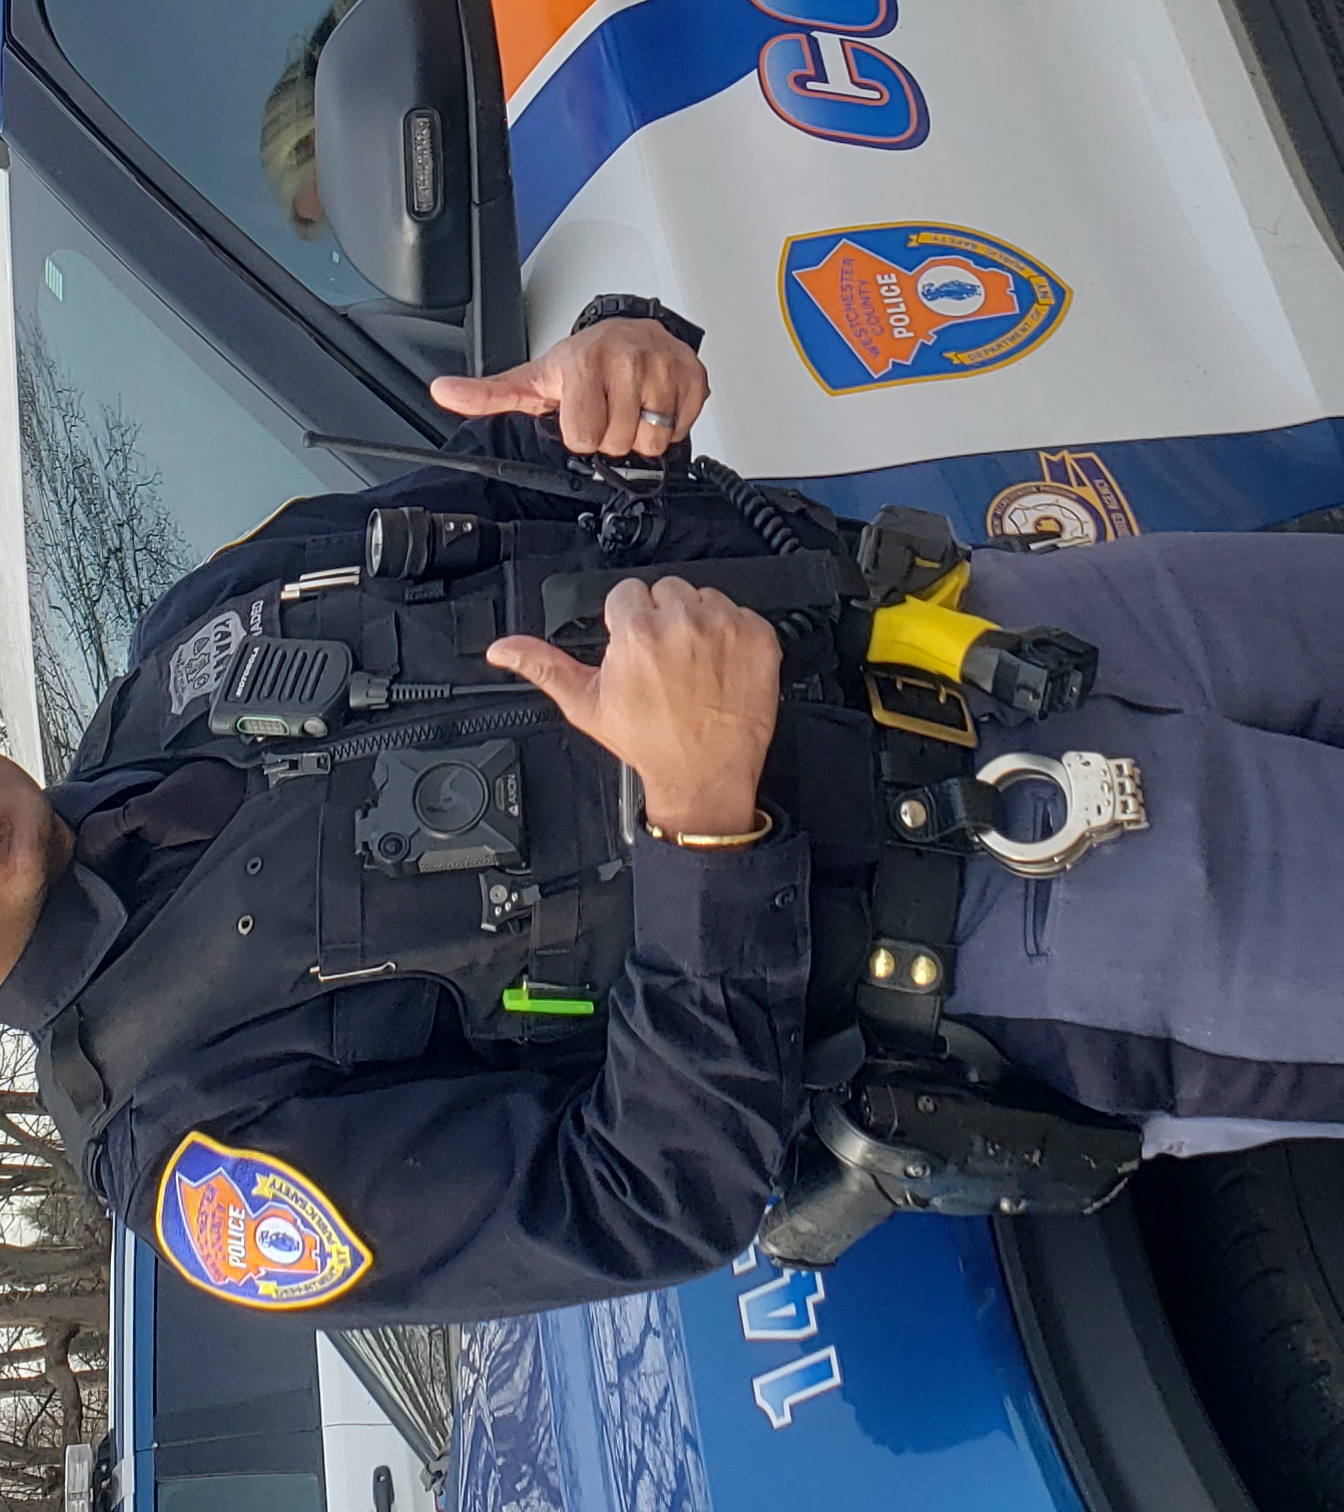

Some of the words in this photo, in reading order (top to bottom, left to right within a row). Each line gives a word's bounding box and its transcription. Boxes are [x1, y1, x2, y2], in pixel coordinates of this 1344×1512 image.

[840, 257, 881, 358] WESTCHESTER
[858, 278, 885, 336] COUNTY
[875, 272, 915, 339] POLICE
[1035, 282, 1051, 300] NY
[235, 646, 261, 698] MOTOROLA
[227, 1204, 247, 1269] POLICE
[731, 1194, 842, 1430] 14
